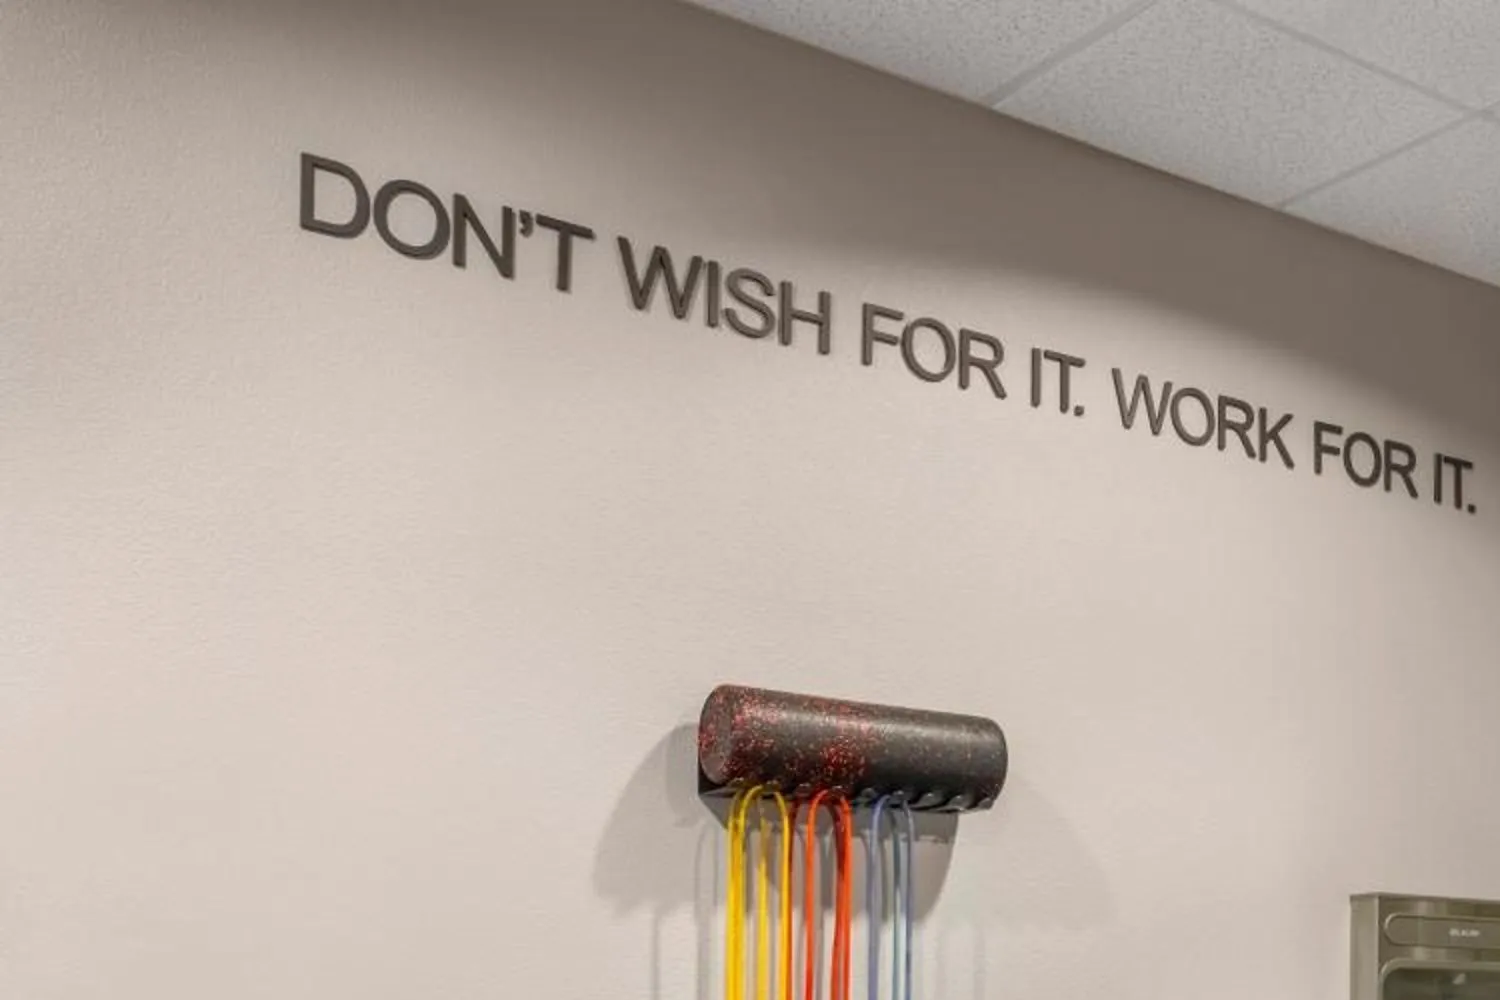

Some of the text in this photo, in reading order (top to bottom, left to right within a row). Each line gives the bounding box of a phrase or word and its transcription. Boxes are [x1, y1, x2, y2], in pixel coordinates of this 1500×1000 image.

[300, 152, 1476, 514] DON'T WISH FOR IT. WORK FOR IT.
